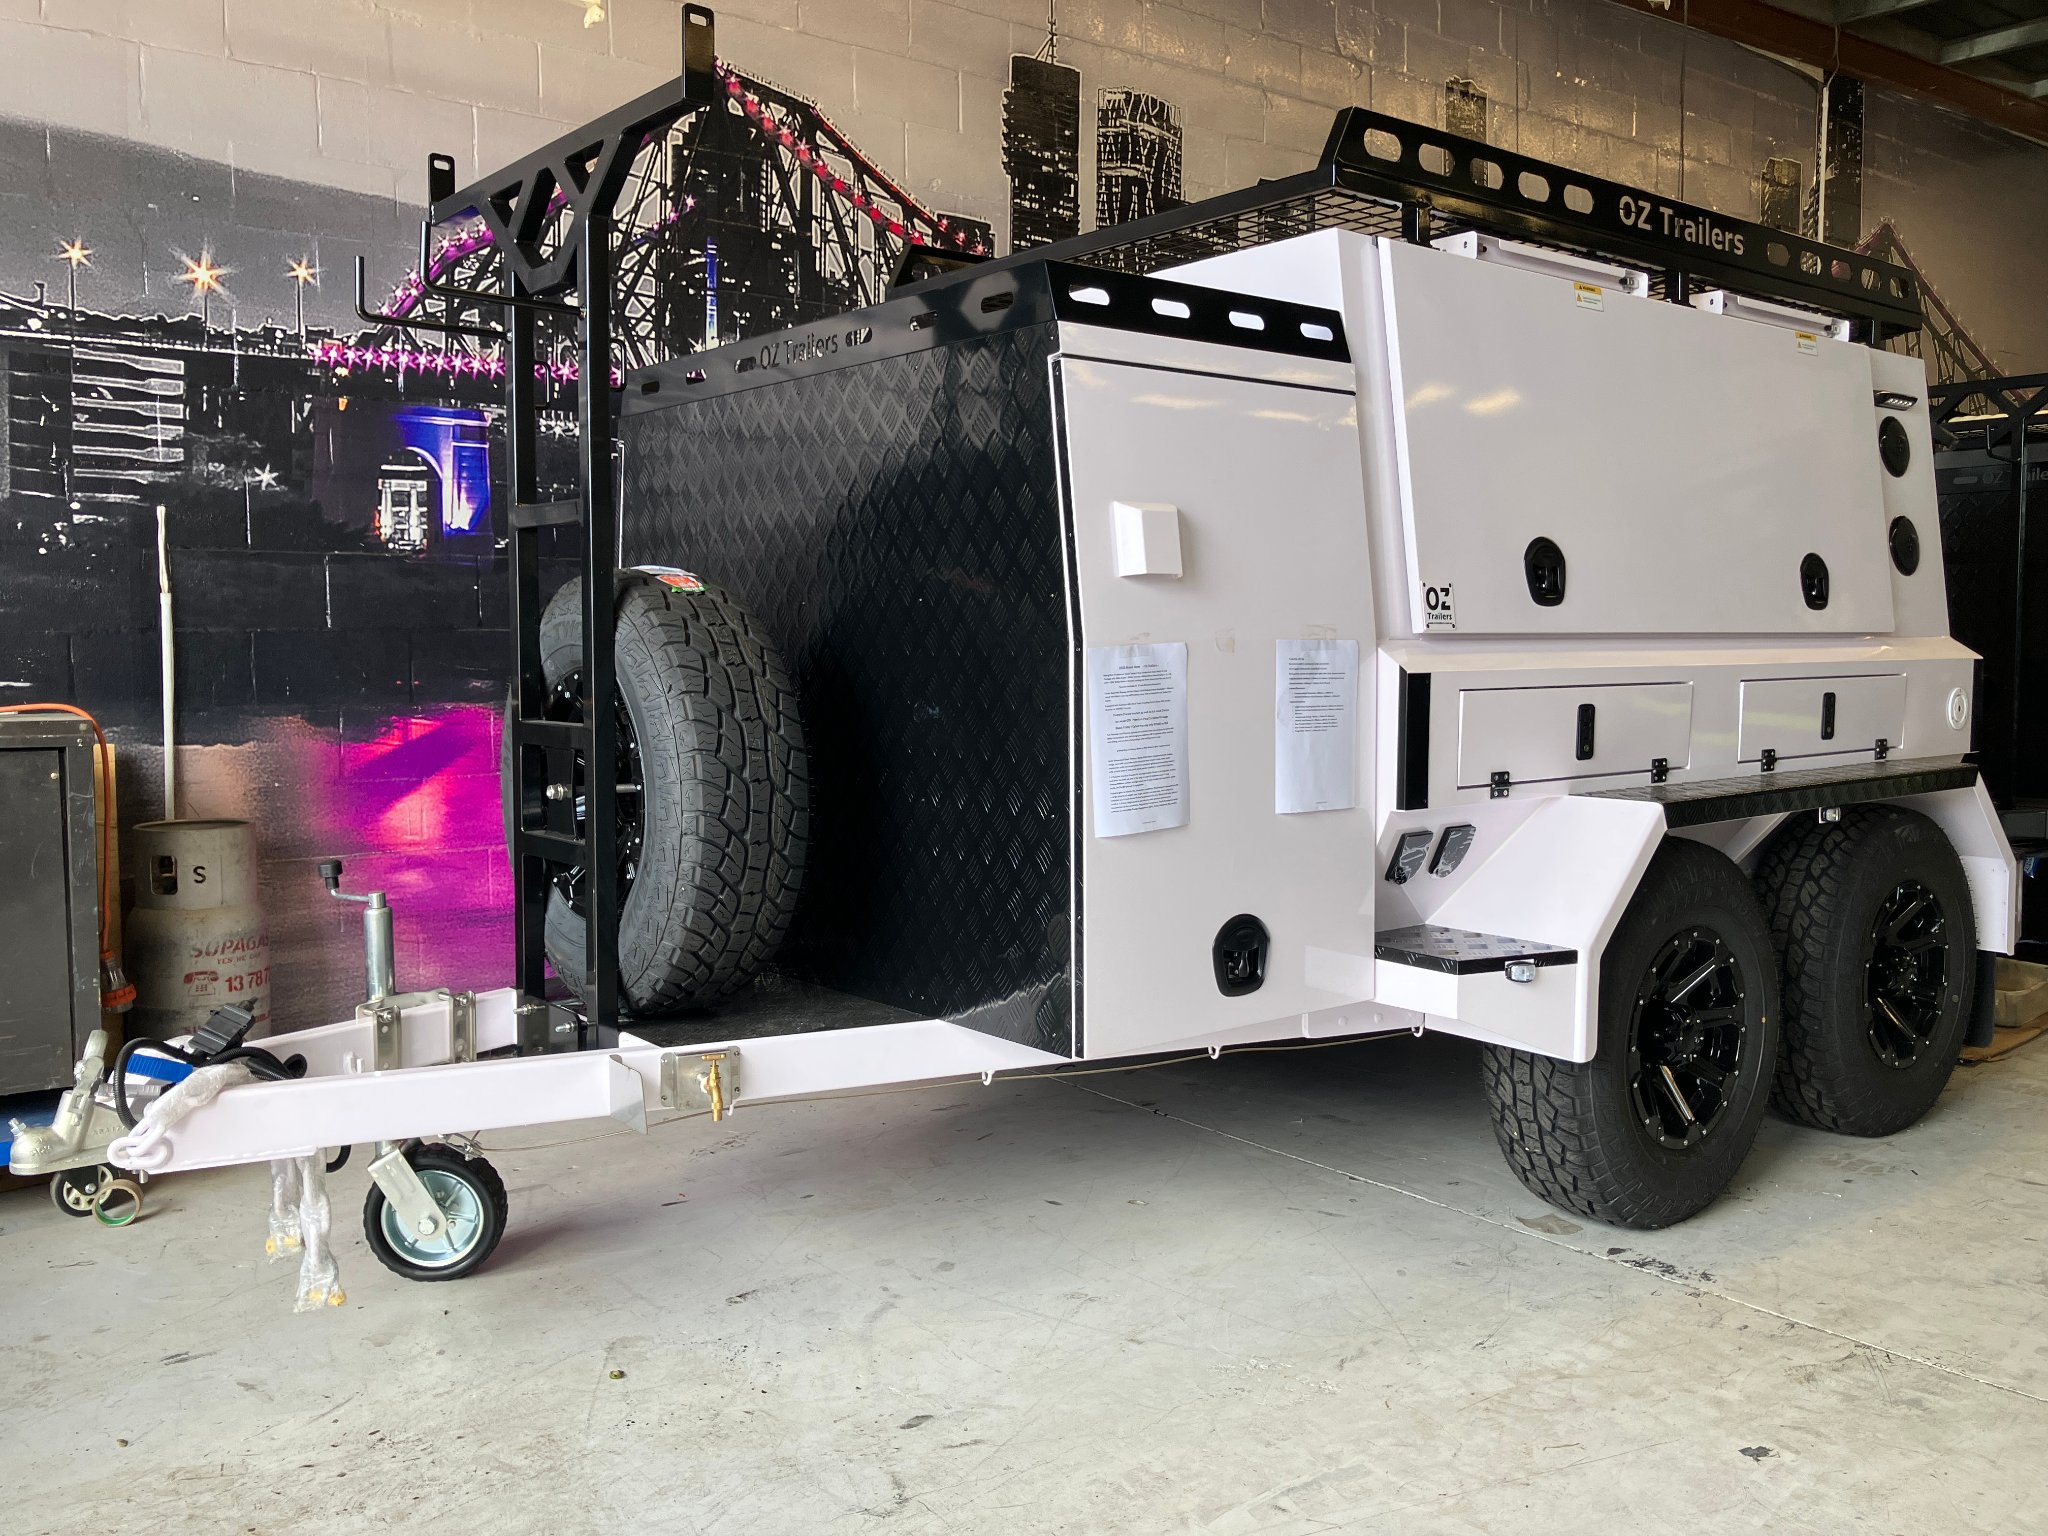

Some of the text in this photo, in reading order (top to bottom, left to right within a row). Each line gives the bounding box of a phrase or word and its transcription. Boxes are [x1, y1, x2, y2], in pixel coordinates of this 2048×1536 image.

[1619, 195, 1744, 255] OZ Trailers
[760, 332, 838, 369] OZ Trailers
[1425, 586, 1451, 611] OZ
[1427, 612, 1453, 621] Trailers
[193, 865, 207, 884] S
[225, 975, 244, 993] 13
